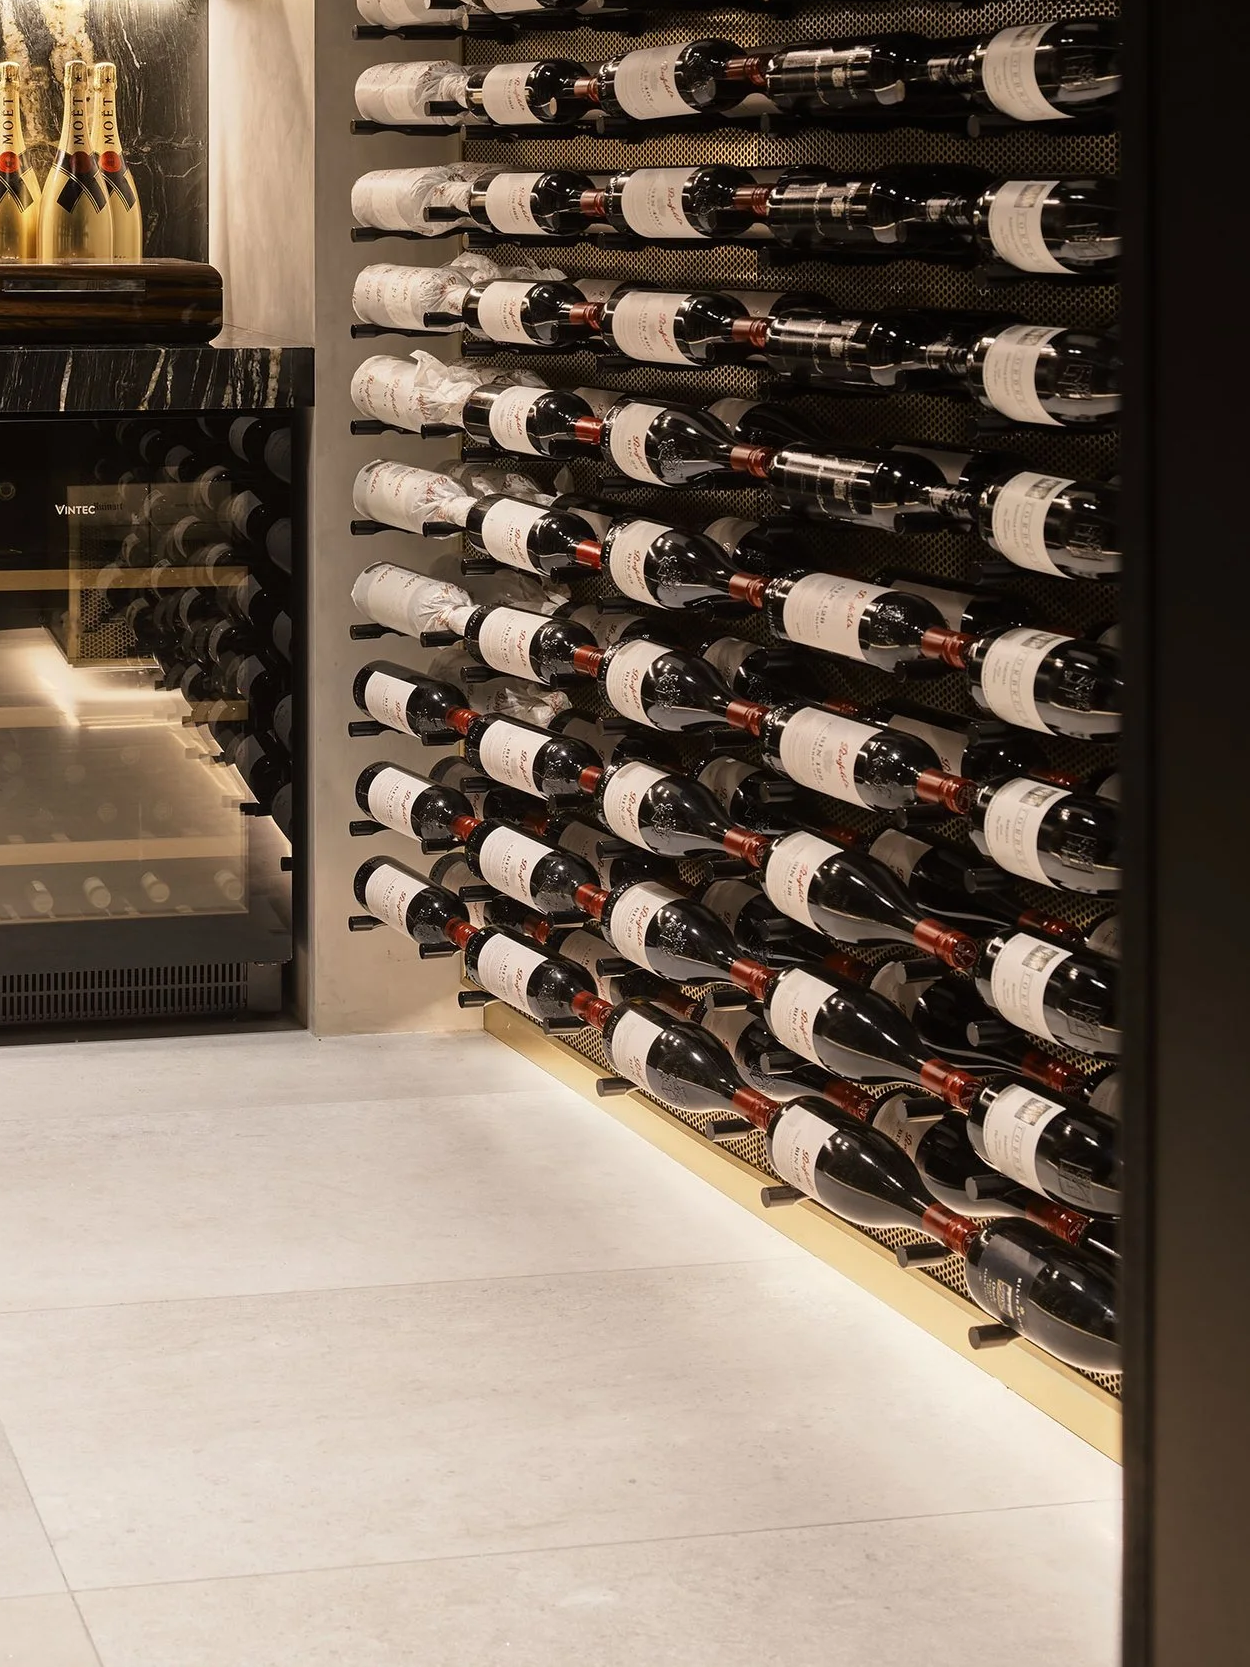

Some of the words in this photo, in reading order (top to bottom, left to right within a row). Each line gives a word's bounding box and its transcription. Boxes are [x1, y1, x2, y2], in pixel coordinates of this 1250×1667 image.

[2, 97, 14, 145] MOËT
[72, 97, 85, 145] MOËT
[103, 98, 115, 145] MOËT
[54, 504, 96, 515] VINTEC
[836, 742, 849, 788] Penfolds
[636, 905, 650, 948] Penfolds
